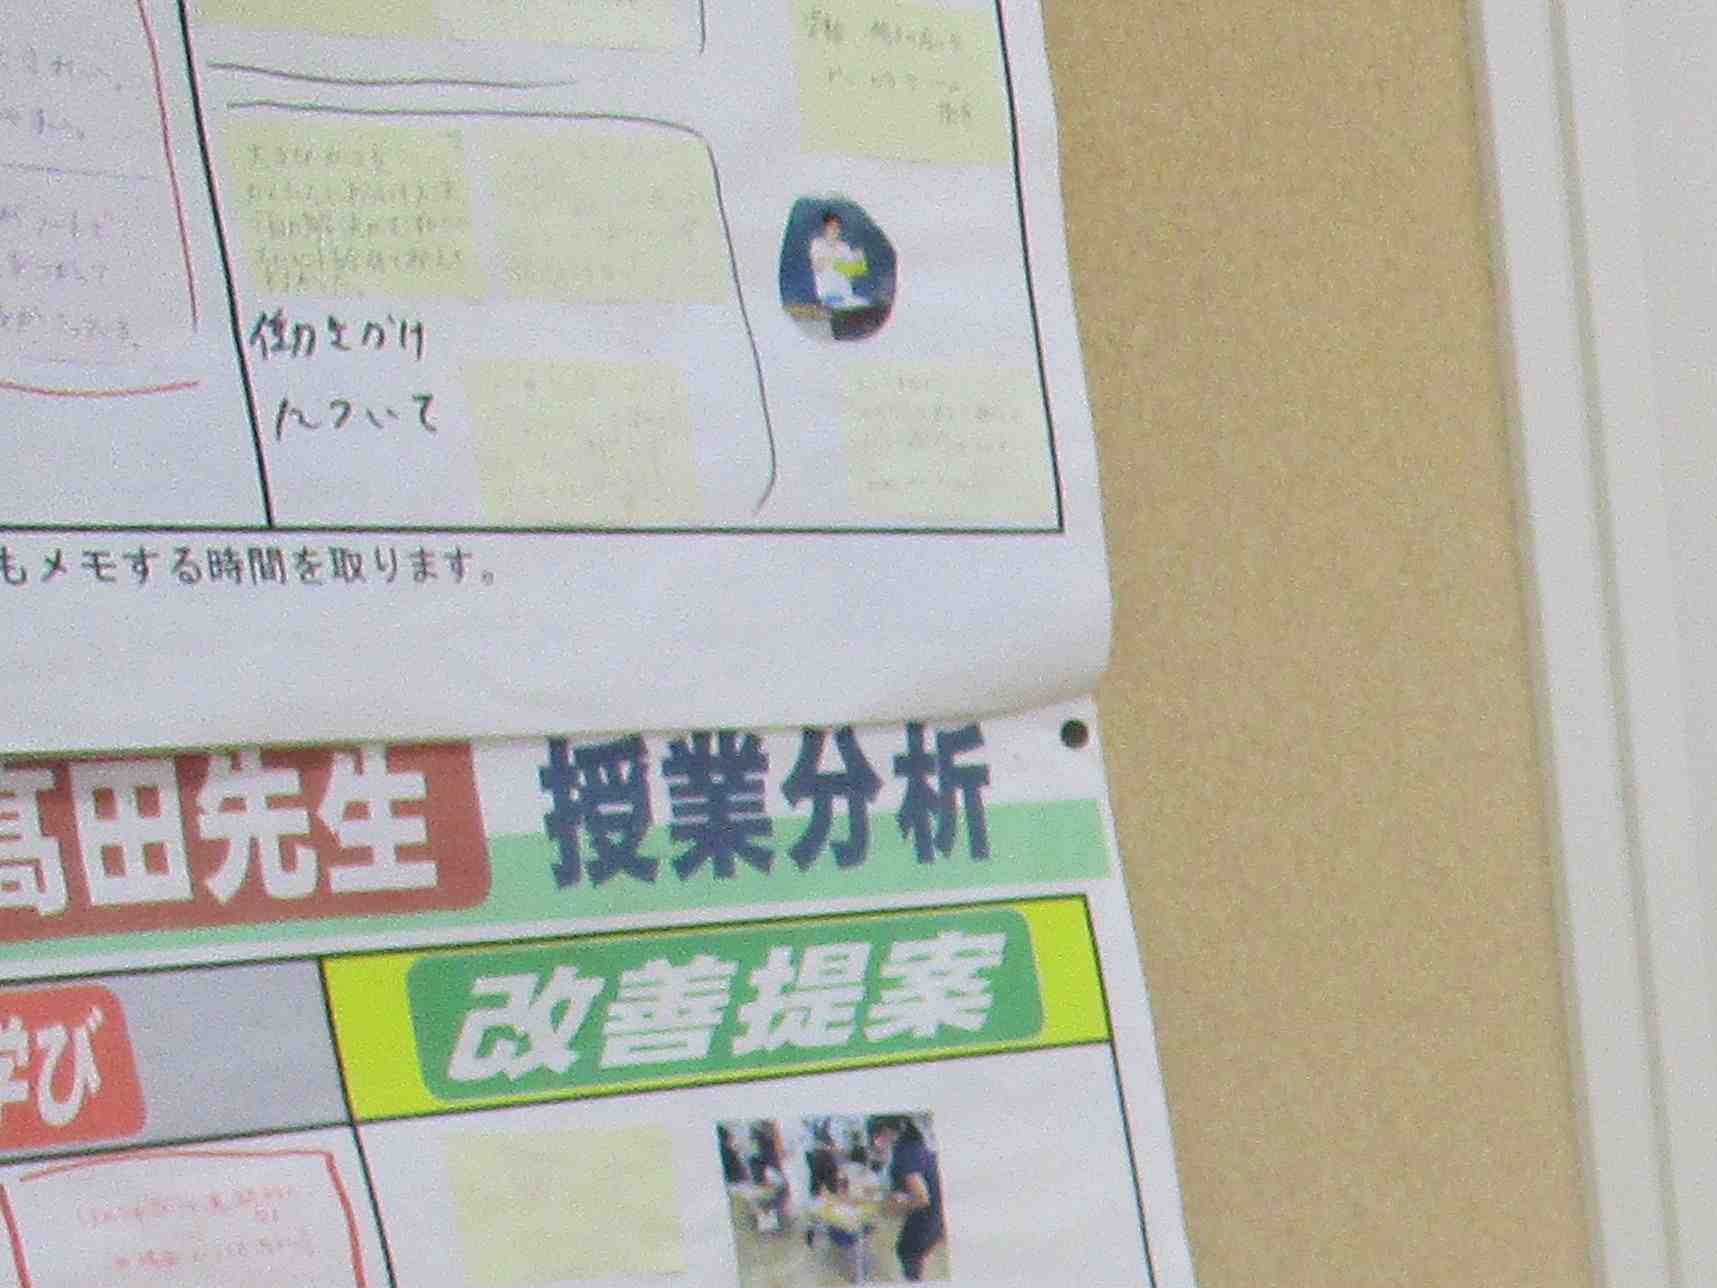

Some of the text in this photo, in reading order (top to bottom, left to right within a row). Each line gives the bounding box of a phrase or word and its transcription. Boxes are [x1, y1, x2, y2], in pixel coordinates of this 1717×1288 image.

[274, 393, 438, 441] について
[0, 546, 496, 588] もメモする時間を取ります。
[539, 720, 991, 888] 授業分析
[0, 1006, 103, 1127] び
[446, 931, 1008, 1083] 改善提案
